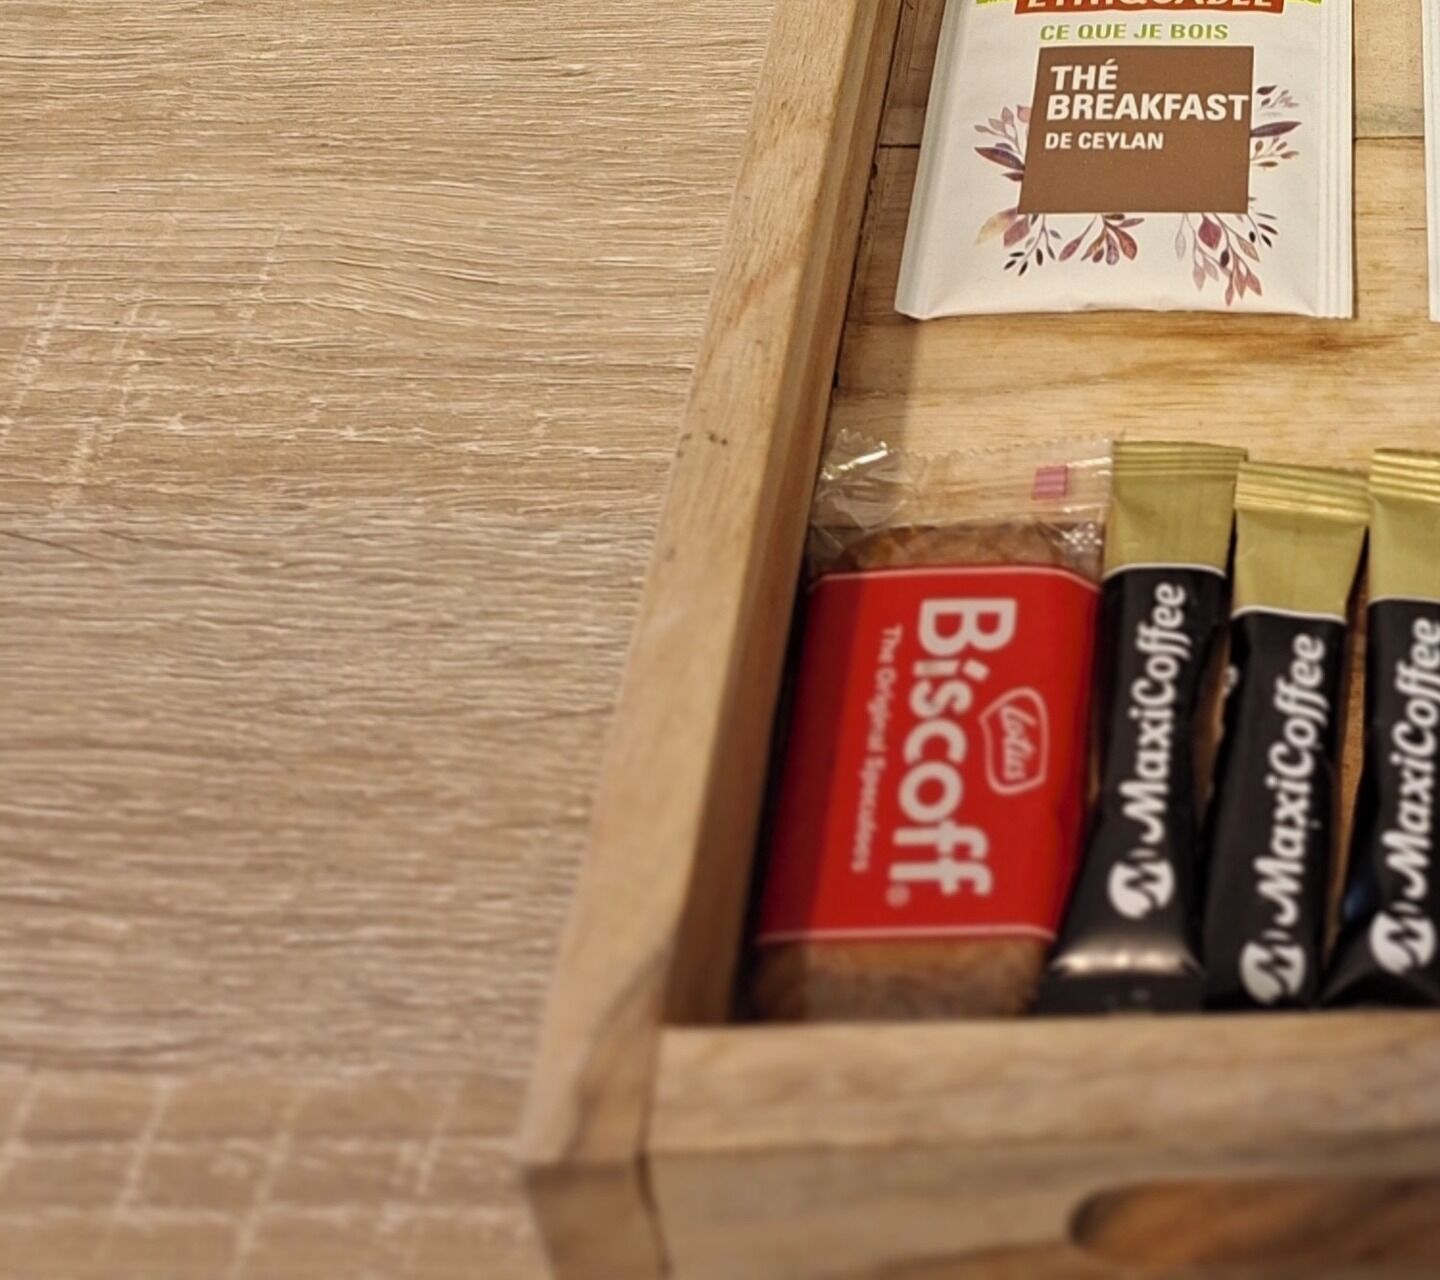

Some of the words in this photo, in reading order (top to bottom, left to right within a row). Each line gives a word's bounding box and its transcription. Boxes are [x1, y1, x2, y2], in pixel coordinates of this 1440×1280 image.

[1040, 25, 1069, 41] CE
[1078, 23, 1126, 40] QUE
[1134, 23, 1161, 40] JE
[1170, 23, 1228, 40] BOIS
[1050, 59, 1118, 91] THÉ
[1046, 93, 1249, 121] BREAKFAST
[1045, 132, 1072, 150] DE
[1078, 132, 1164, 150] CEYLAN
[1119, 583, 1192, 844] MaxiCoffee
[1254, 633, 1329, 926] MaxiCoffee
